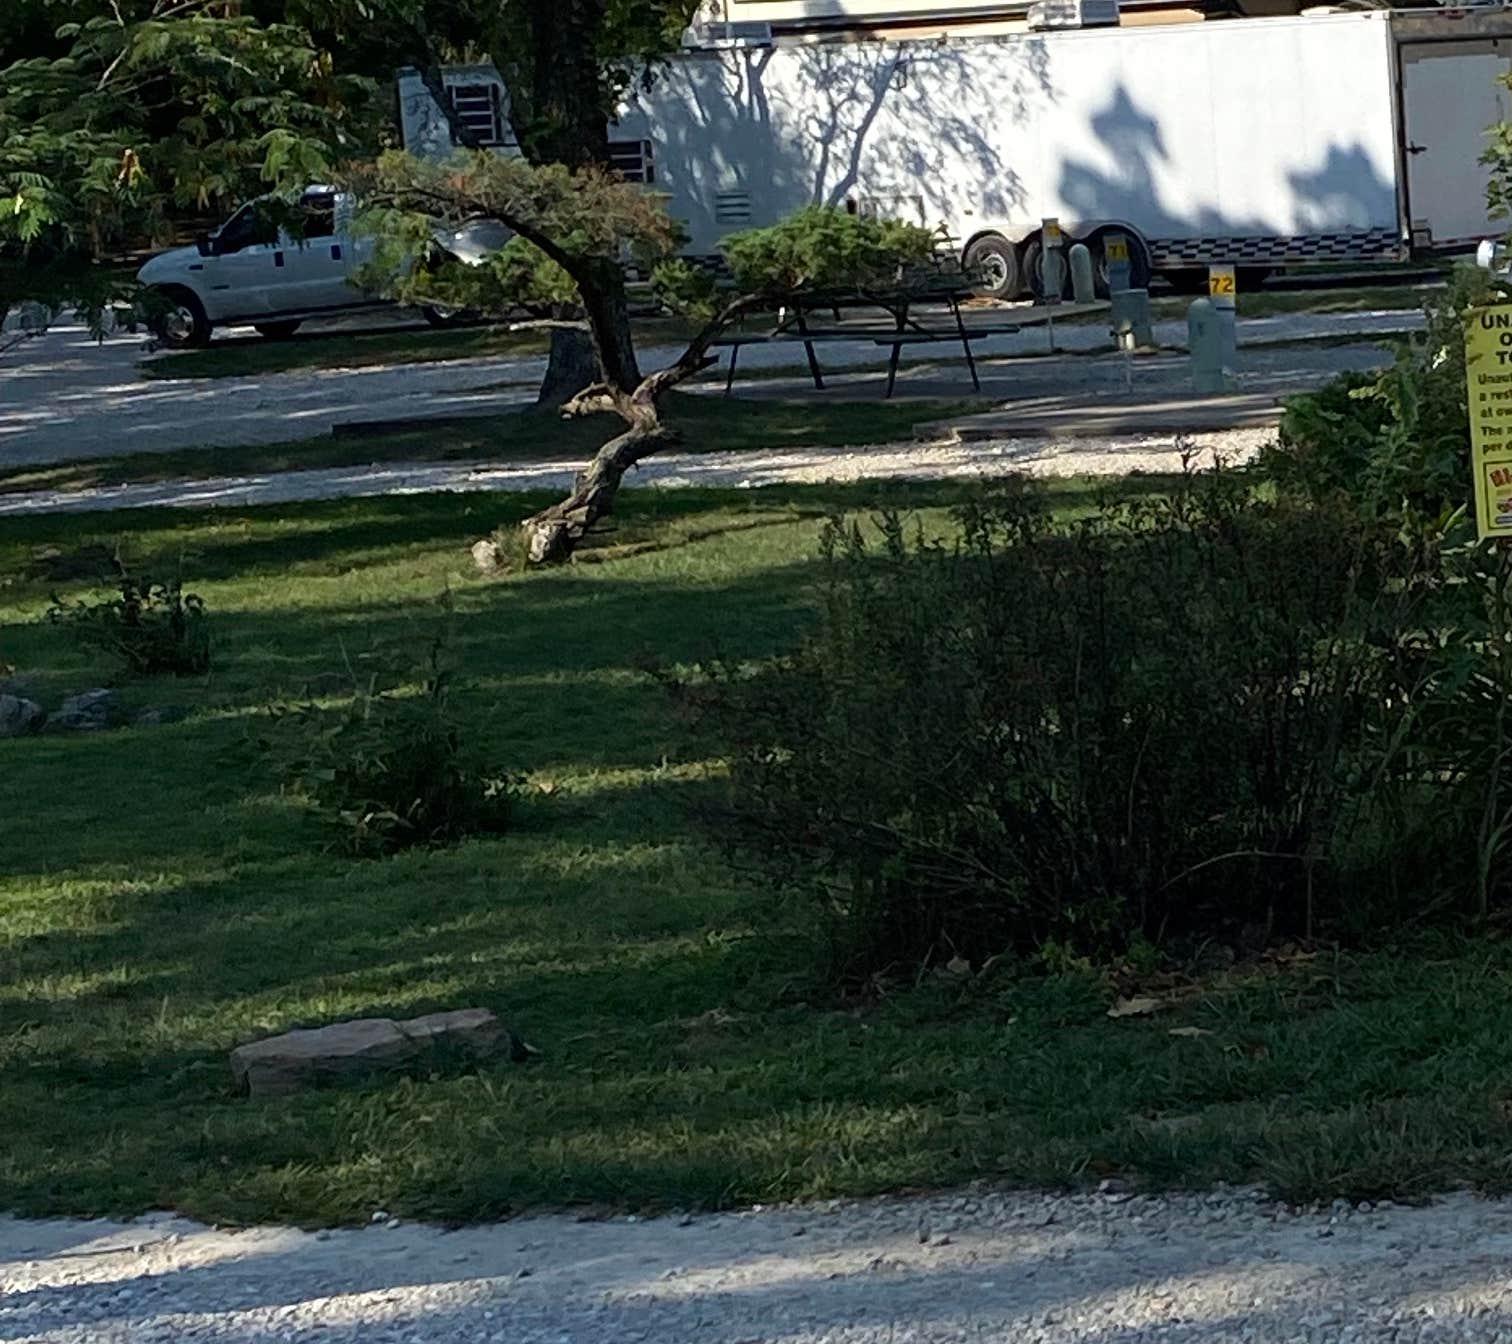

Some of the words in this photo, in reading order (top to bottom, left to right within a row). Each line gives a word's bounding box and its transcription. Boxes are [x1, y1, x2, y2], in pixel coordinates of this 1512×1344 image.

[1210, 278, 1233, 294] 72
[1479, 392, 1486, 402] a
[1480, 407, 1493, 418] at
[1480, 426, 1503, 436] The
[1483, 442, 1502, 454] per
